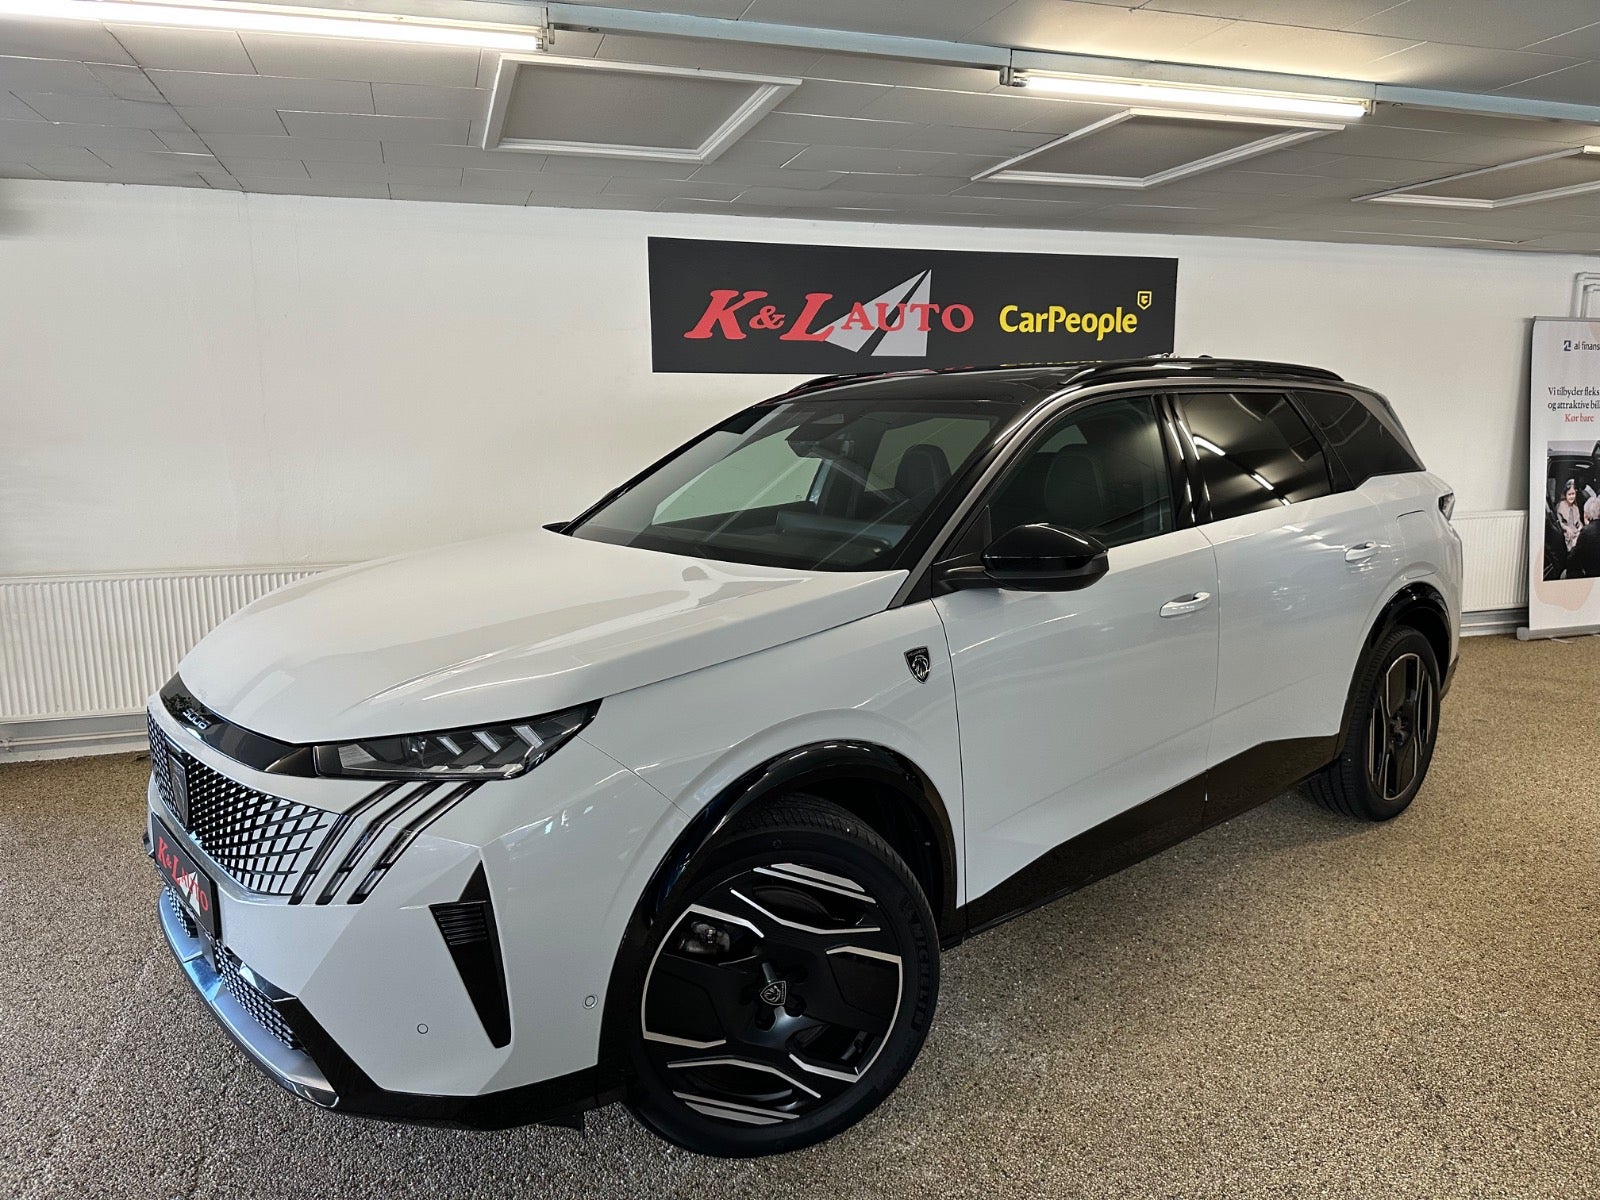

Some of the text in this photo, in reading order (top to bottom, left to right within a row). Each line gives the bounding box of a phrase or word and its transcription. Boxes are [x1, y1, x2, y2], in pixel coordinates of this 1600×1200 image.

[842, 302, 974, 332] AUTO
[999, 304, 1138, 341] CarPeople
[1548, 387, 1556, 396] Vi
[1556, 386, 1583, 398] tilbyder
[1547, 402, 1557, 411] og
[1557, 400, 1590, 409] attraktive
